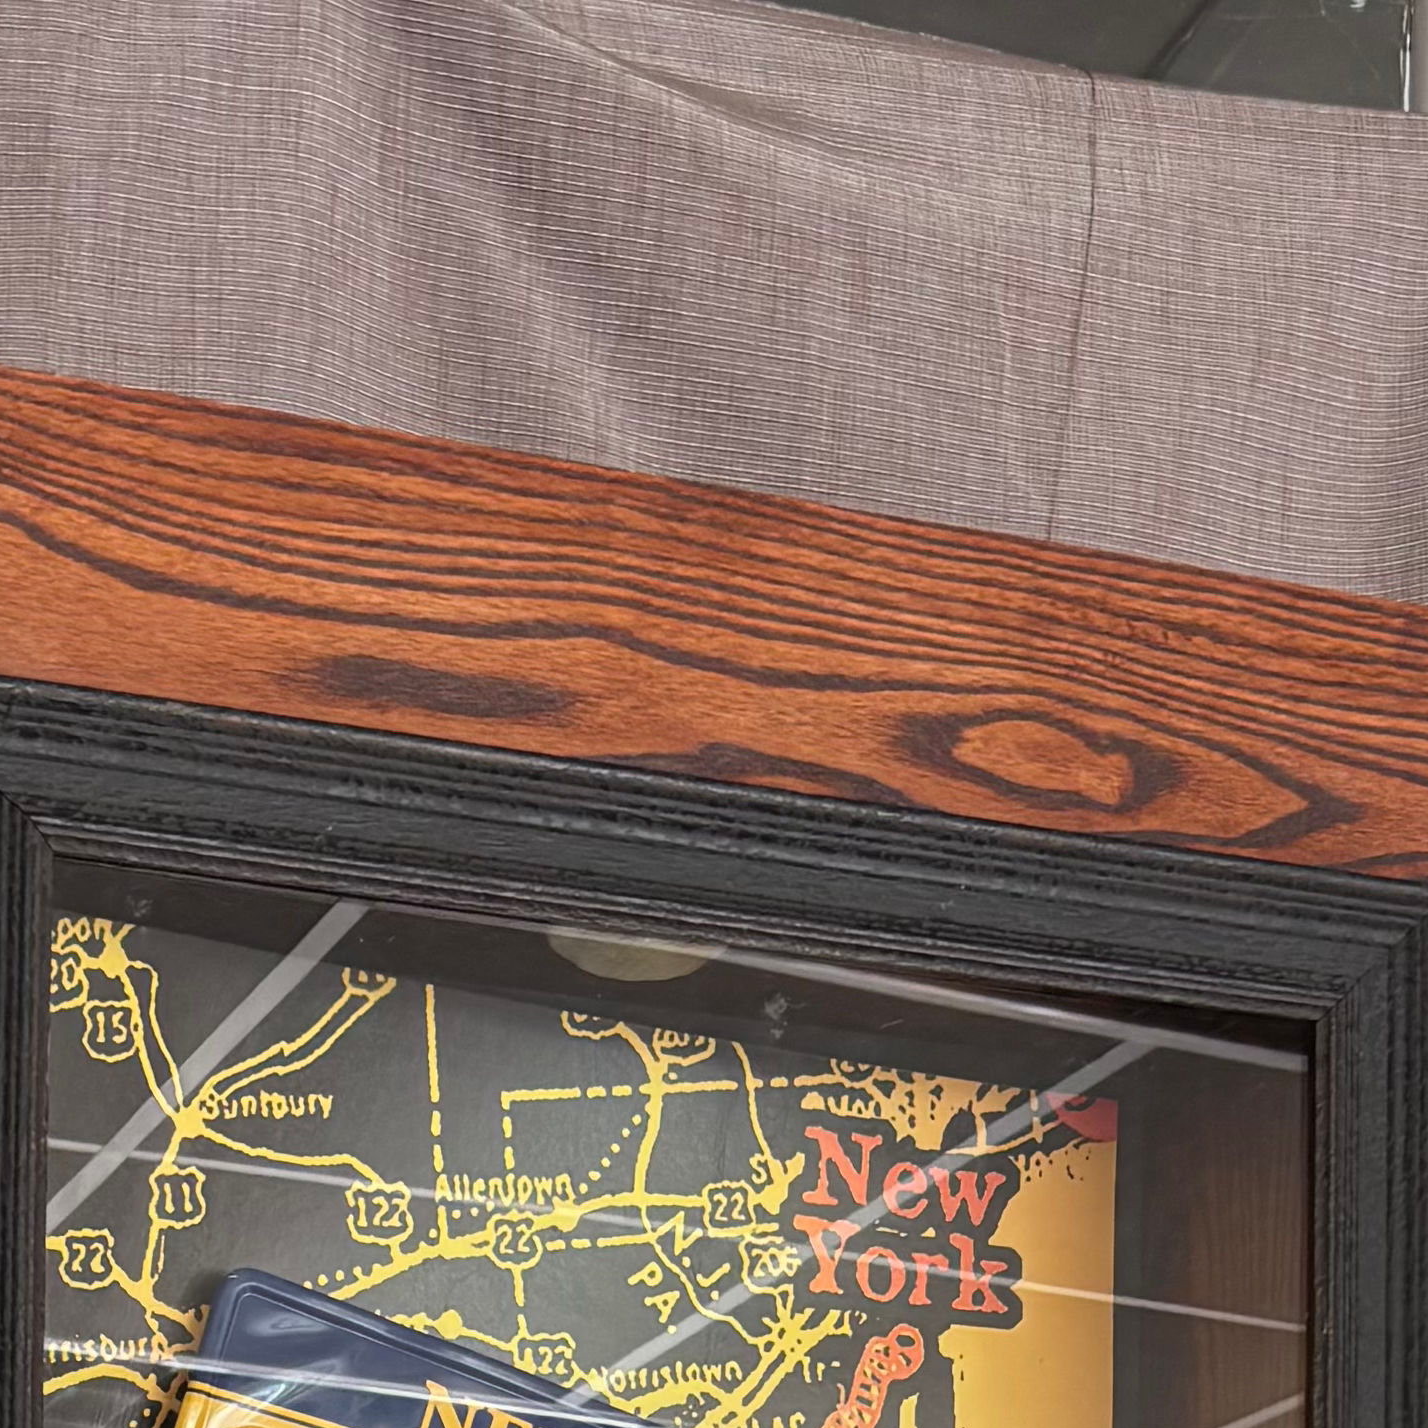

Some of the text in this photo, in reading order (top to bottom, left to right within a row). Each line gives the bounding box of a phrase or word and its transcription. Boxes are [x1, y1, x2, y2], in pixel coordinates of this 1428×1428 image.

[96, 1011, 128, 1045] 15
[801, 1126, 1006, 1226] New
[163, 1182, 194, 1214] 11
[713, 1192, 747, 1222] 22
[495, 1224, 532, 1254] 22
[72, 1242, 105, 1274] 22
[792, 1213, 1009, 1315] York
